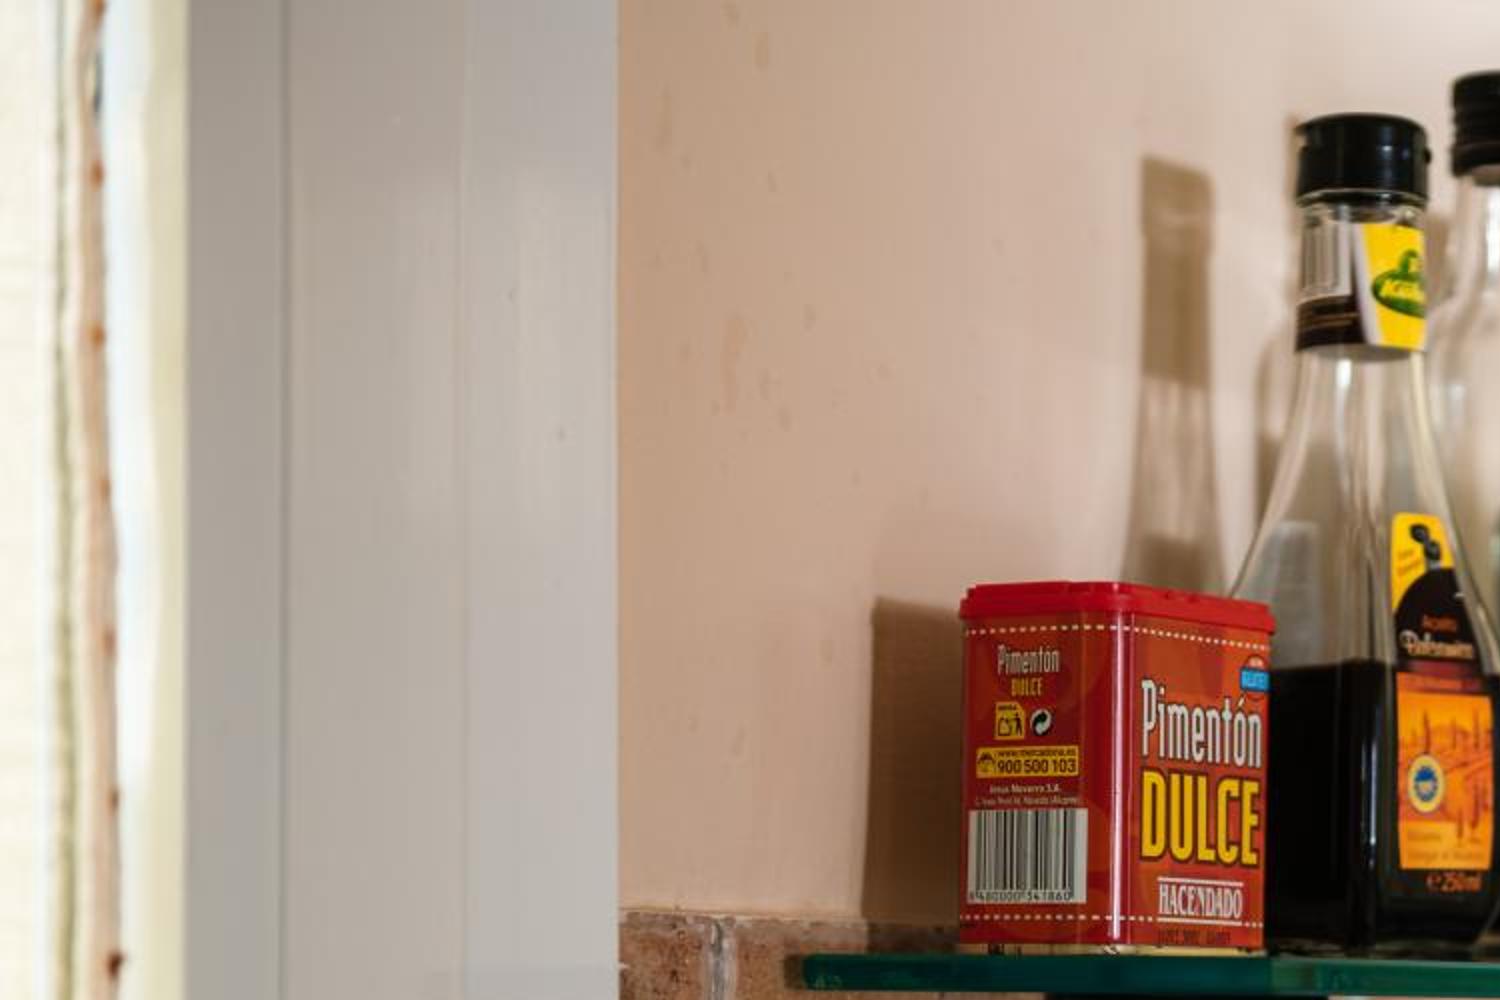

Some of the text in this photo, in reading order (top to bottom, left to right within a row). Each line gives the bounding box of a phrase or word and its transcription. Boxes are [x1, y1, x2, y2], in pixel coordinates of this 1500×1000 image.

[997, 644, 1060, 675] Pimentón
[1011, 677, 1043, 697] DULCE
[1141, 678, 1262, 769] Pimentón
[997, 757, 1077, 774] 900 500 103
[1140, 769, 1260, 867] DULCE
[1158, 882, 1243, 920] HACENDADO
